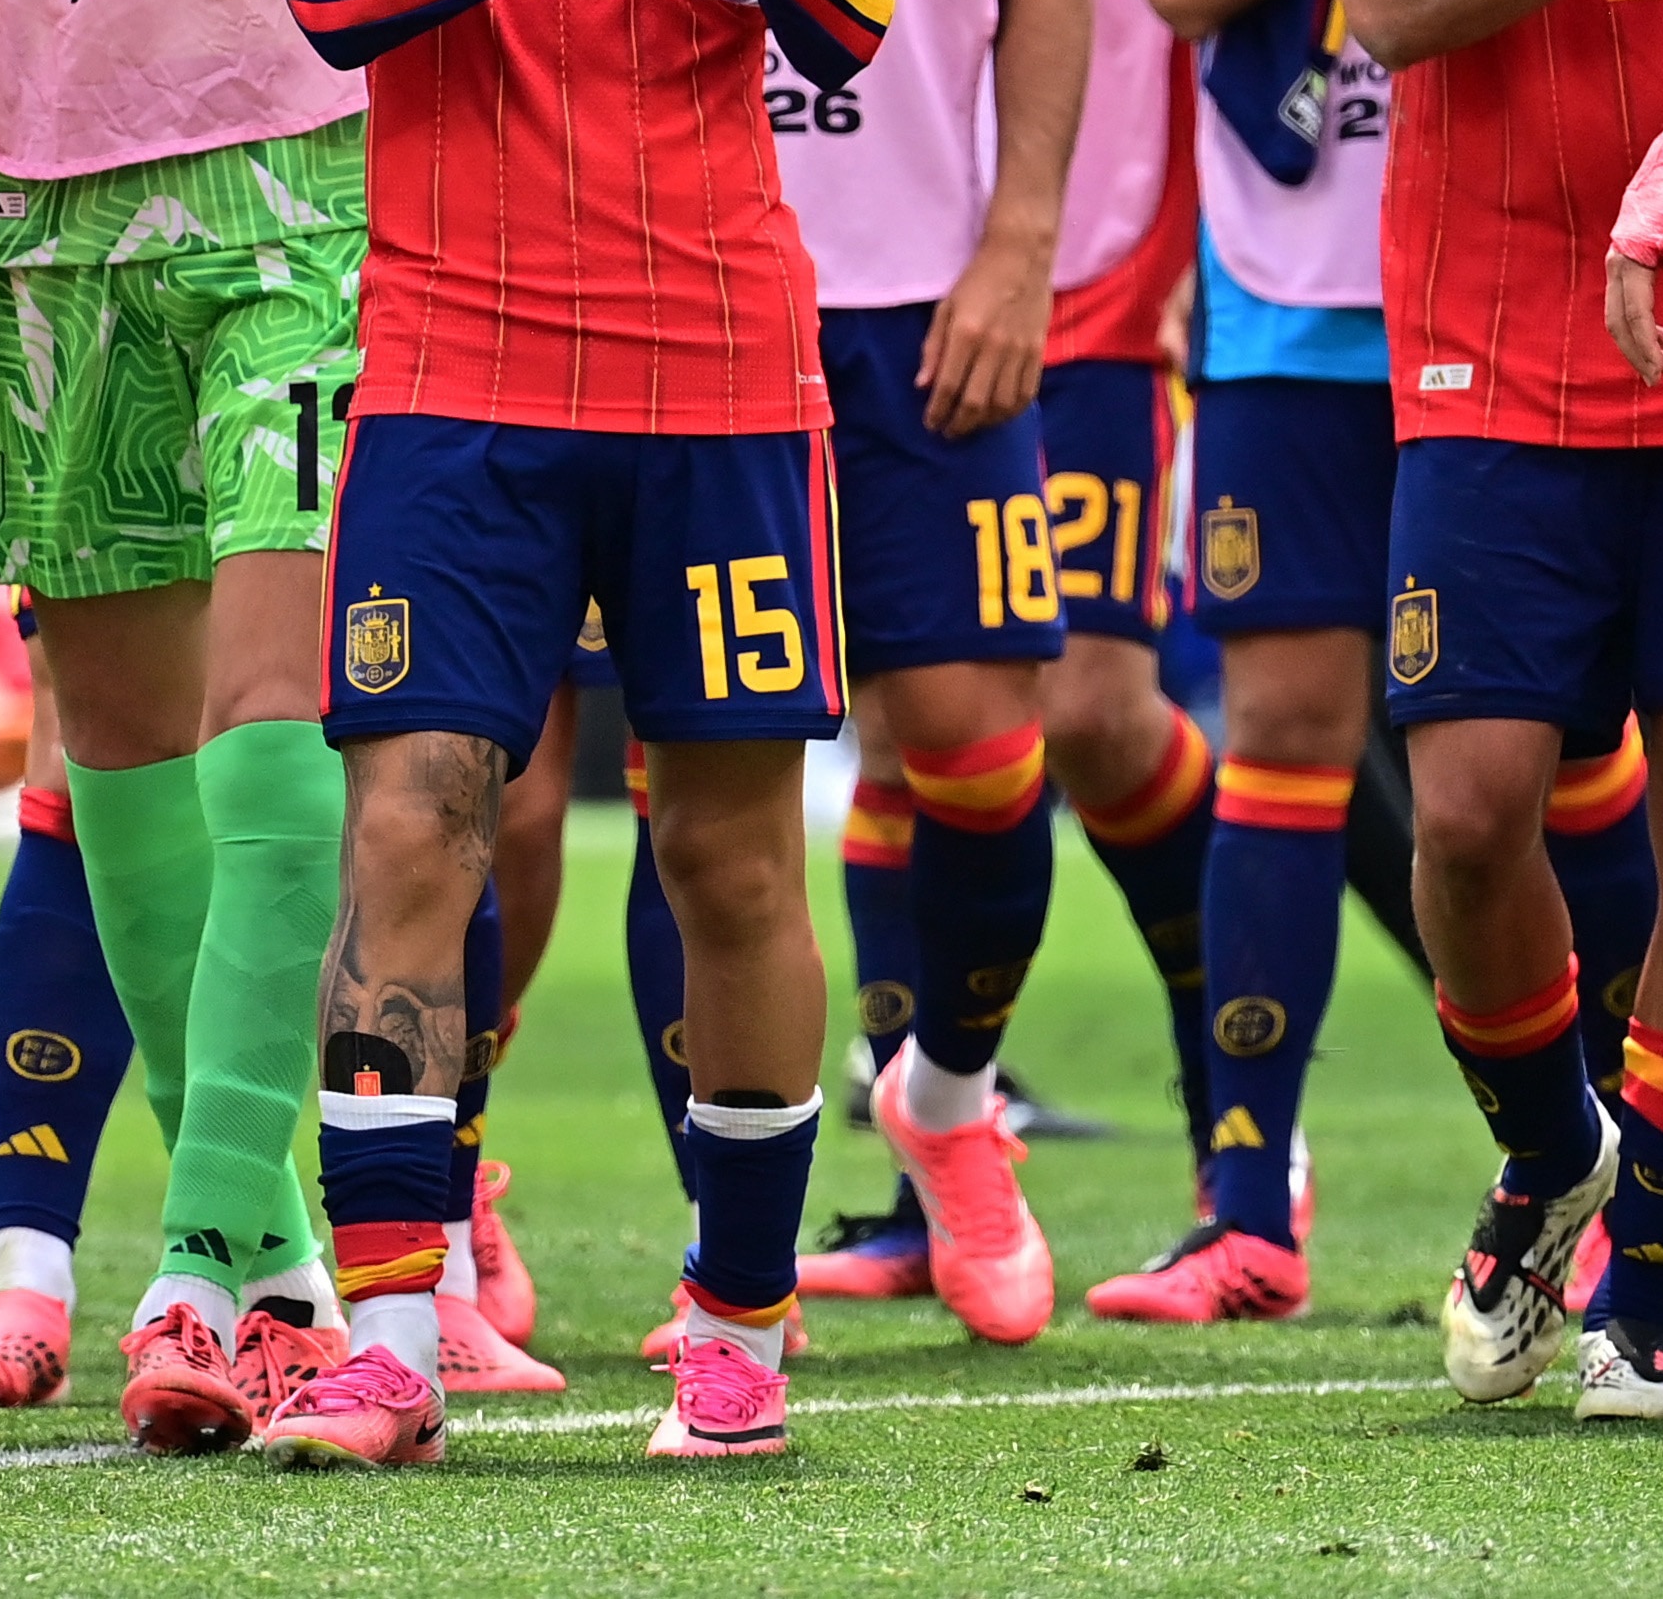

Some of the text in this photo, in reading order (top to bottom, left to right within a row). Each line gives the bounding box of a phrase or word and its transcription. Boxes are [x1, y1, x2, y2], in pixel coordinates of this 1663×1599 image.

[766, 90, 863, 136] 26
[288, 381, 351, 512] 1
[967, 493, 1059, 628] 18
[1049, 472, 1142, 602] 21
[685, 555, 805, 700] 15
